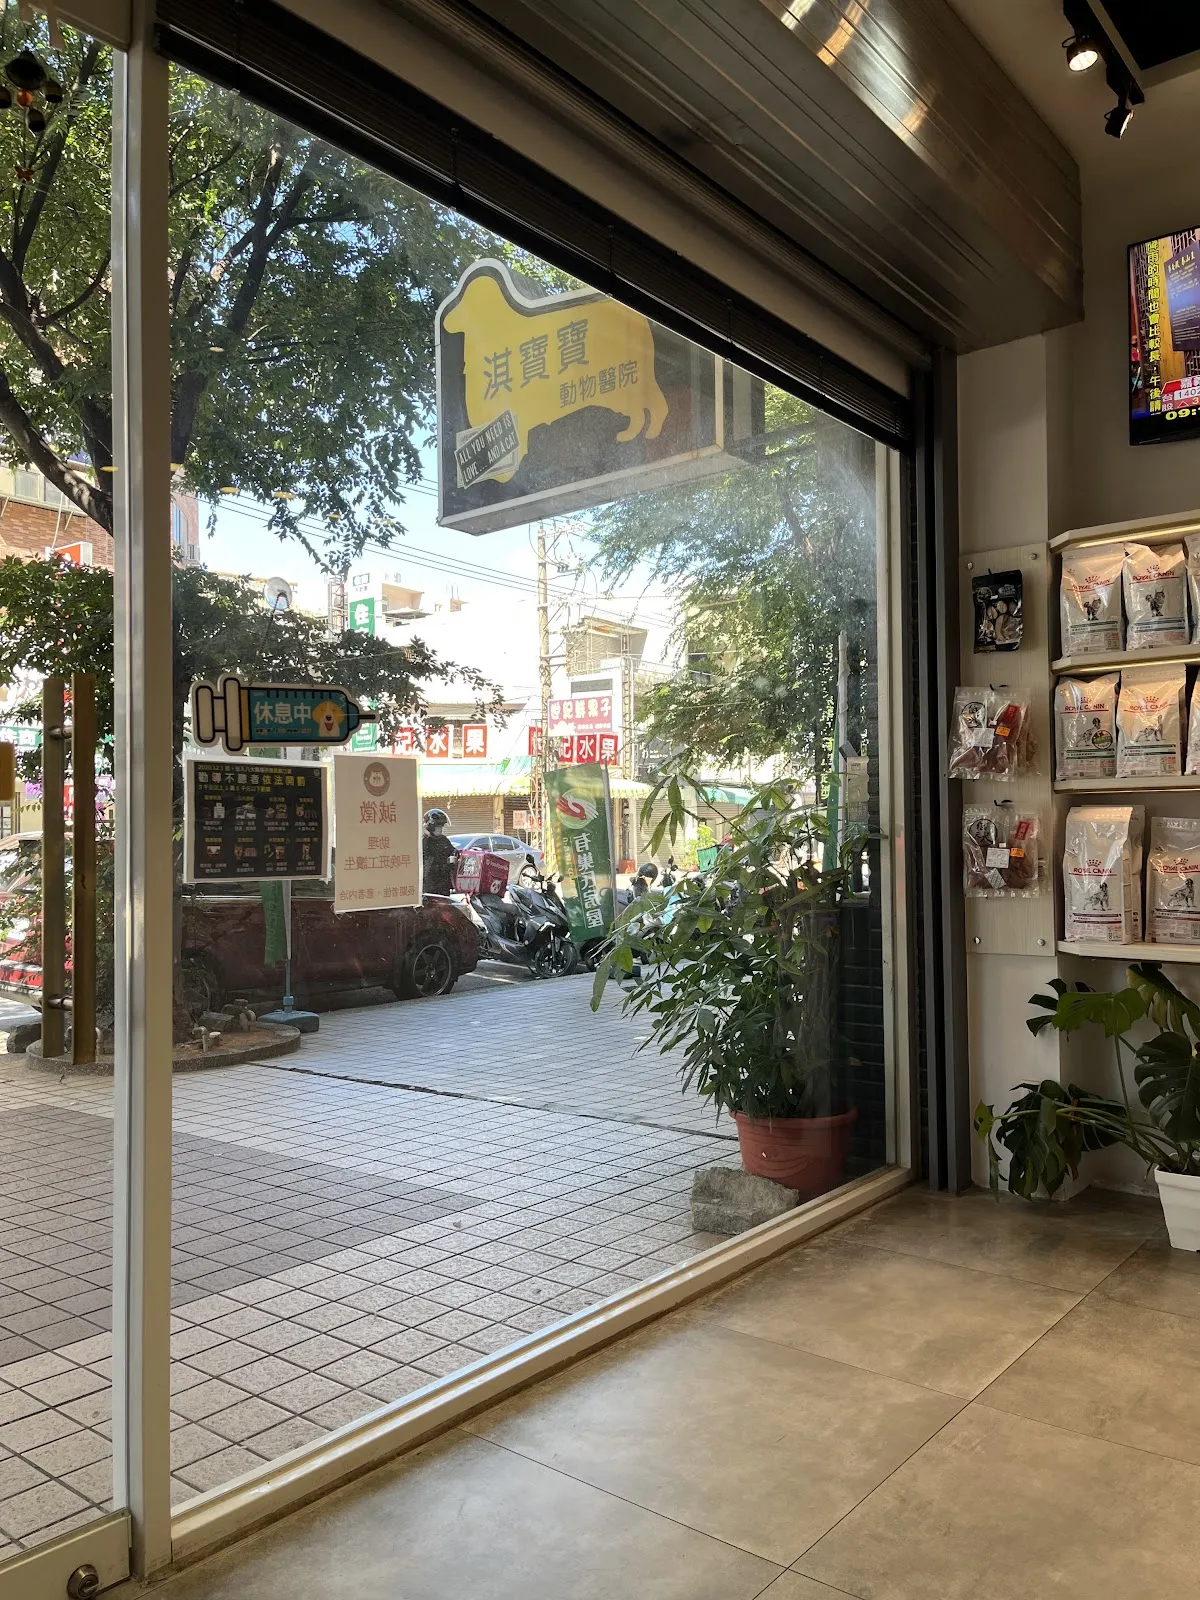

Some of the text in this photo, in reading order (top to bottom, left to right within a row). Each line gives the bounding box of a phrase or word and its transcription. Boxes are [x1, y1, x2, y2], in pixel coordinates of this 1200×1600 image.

[483, 318, 590, 400] 淇寶寶
[559, 359, 638, 409] 動物醫院
[459, 414, 512, 466] ALL YOU NEED IS
[487, 445, 501, 465] AND
[504, 431, 517, 450] CAT
[253, 701, 312, 725] 休息中
